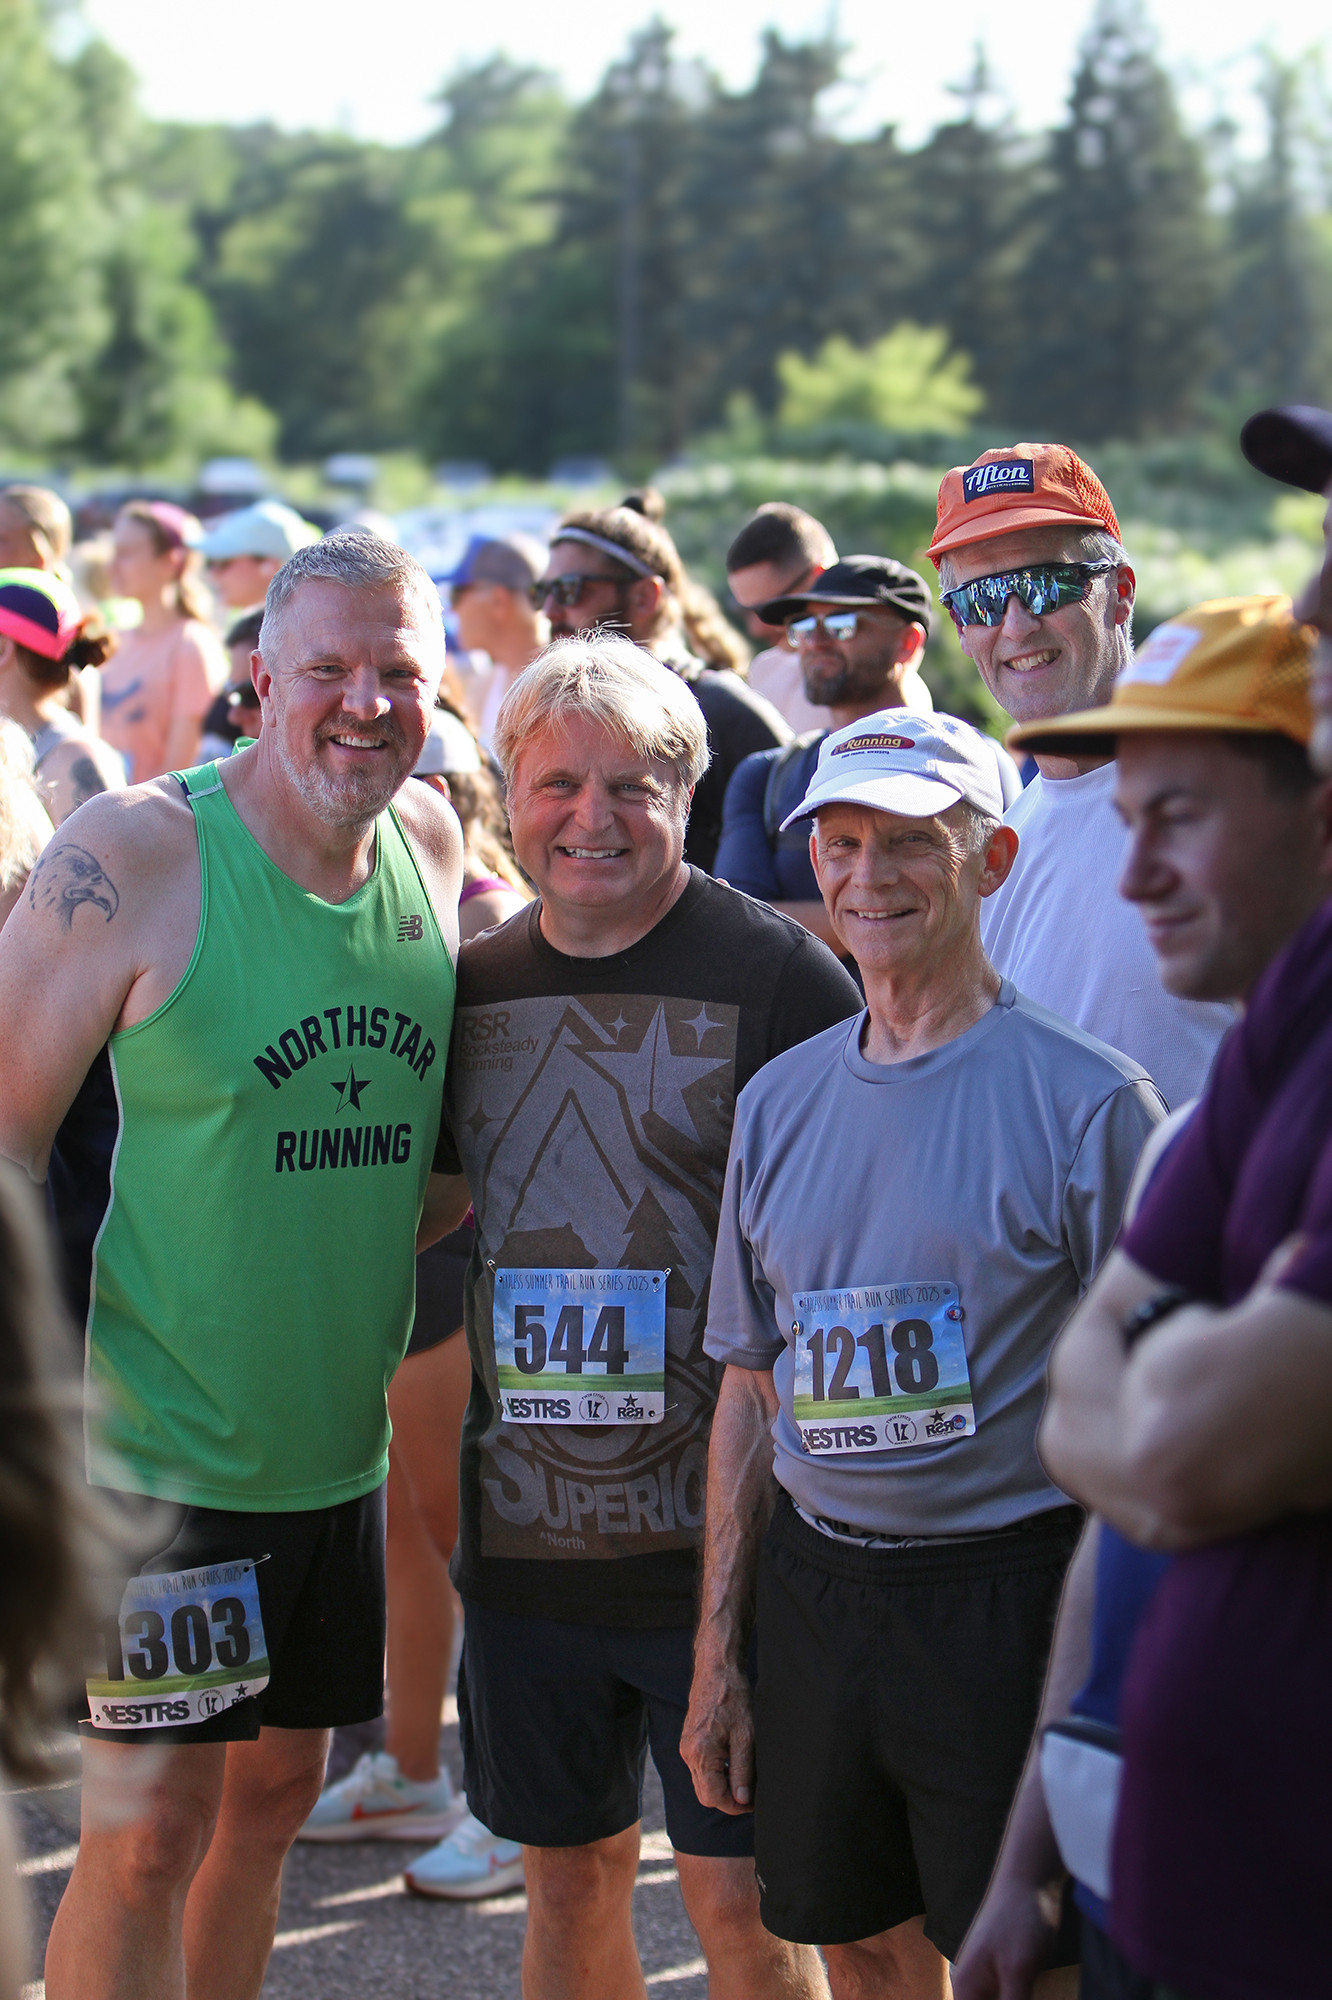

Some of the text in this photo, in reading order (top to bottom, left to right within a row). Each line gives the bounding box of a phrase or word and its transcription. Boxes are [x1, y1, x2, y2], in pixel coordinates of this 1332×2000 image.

[966, 465, 1029, 492] Afton
[846, 736, 902, 750] Running
[461, 1011, 511, 1041] RSR
[253, 1005, 437, 1090] NORTHSTAR
[459, 1035, 540, 1057] Rocksteady
[458, 1056, 514, 1073] Running
[275, 1123, 413, 1173] RUNNING
[525, 1274, 553, 1290] SUMMER
[556, 1274, 576, 1290] TRAIL
[580, 1274, 595, 1290] RUN
[598, 1275, 624, 1291] SERIES
[627, 1275, 649, 1291] 2025
[844, 1291, 862, 1311] TRAIL
[865, 1289, 882, 1308] RUN
[885, 1288, 912, 1306] SERIES
[915, 1286, 940, 1303] 2025
[514, 1305, 629, 1375] 544
[806, 1318, 939, 1401] 1218
[548, 1535, 586, 1550] North
[182, 1574, 197, 1591] RUN
[198, 1570, 220, 1588] SERIES
[222, 1566, 242, 1583] 2025
[100, 1597, 250, 1681] 1303
